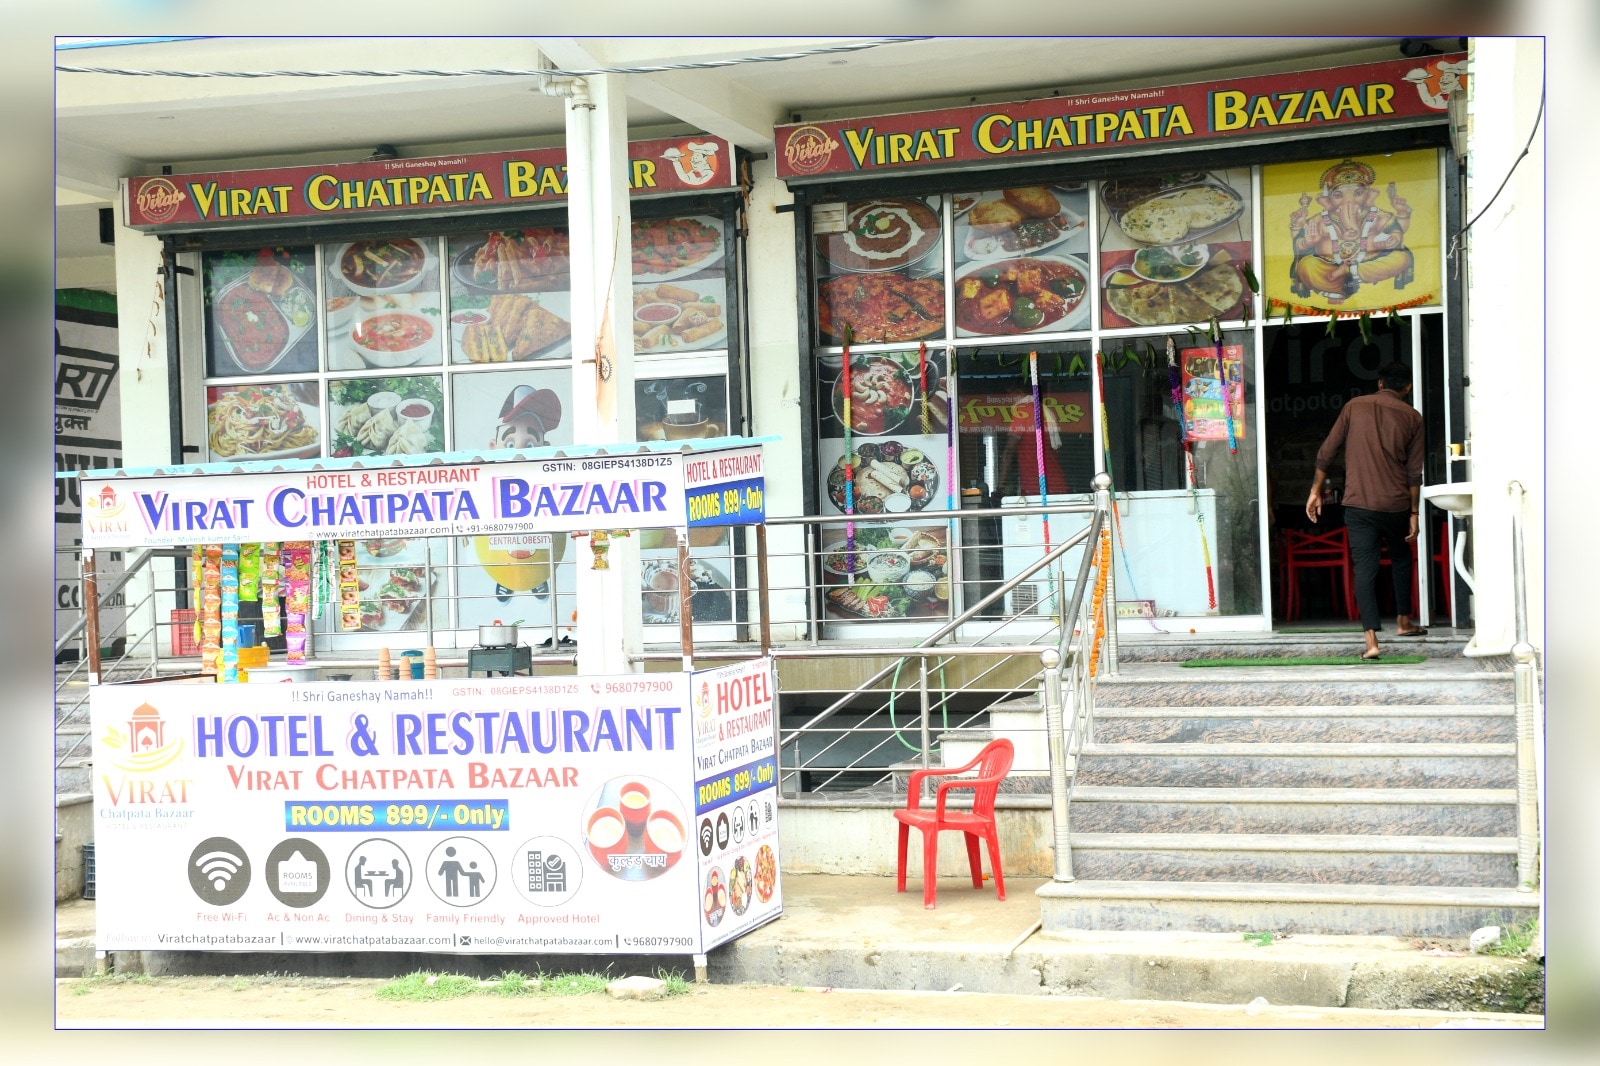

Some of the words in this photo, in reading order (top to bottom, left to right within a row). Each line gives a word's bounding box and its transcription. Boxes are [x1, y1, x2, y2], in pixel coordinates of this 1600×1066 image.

[1075, 97, 1090, 106] Shri
[1091, 94, 1129, 104] Ganeshay
[844, 126, 960, 169] VIRAT
[977, 105, 1194, 154] CHATPATA
[1211, 83, 1395, 132] BAZAAR
[391, 162, 404, 170] Shri
[405, 160, 437, 169] Ganeshay
[187, 181, 294, 220] VIRAT
[305, 171, 494, 212] CHATPATA
[542, 462, 576, 473] GSTIN:
[581, 457, 673, 471] 08GIEPS4138D1Z5
[686, 460, 711, 483] HOTEL
[712, 460, 718, 479] &
[719, 454, 761, 478] RESTAURANT
[306, 474, 356, 489] HOTEL
[361, 473, 374, 487] &
[378, 468, 480, 487] RESTAURANT
[139, 491, 255, 532] VIRAT
[272, 486, 480, 528] CHATPATA
[496, 478, 668, 519] BAZAAR
[688, 492, 721, 521] ROOMS
[746, 485, 763, 514] Only
[316, 526, 450, 539] www.viratchatpatabazaar.com
[466, 522, 534, 533] +91-9680797900
[489, 536, 521, 546] CENTRAL
[452, 686, 485, 697] GSTIN:
[490, 685, 579, 696] 08GIEPS4138D1Z5
[605, 681, 673, 694] 9680797900
[717, 672, 771, 715] HOTEL
[302, 690, 324, 702] Shri
[326, 689, 382, 704] Ganeshay
[384, 688, 434, 700] Namah!!
[195, 714, 334, 758] HOTEL
[349, 713, 380, 757] &
[394, 706, 682, 756] RESTAURANT
[718, 723, 725, 741] &
[726, 708, 772, 739] RESTAURANT
[697, 755, 716, 771] VIRAT
[718, 744, 749, 765] CHATPATA
[751, 736, 773, 754] BAZAAR
[226, 764, 303, 790] VIRAT
[315, 763, 455, 791] CHATPATA
[468, 762, 579, 788] BAZAAR
[699, 777, 731, 805] ROOMS
[757, 762, 774, 784] Only
[102, 774, 193, 807] VIRAT
[100, 808, 151, 821] Chatpata
[155, 807, 195, 819] Bazaar
[291, 805, 375, 826] ROOMS
[385, 804, 448, 829] 899/-
[453, 804, 505, 828] Only
[645, 854, 667, 867] चाय
[197, 912, 219, 922] Free
[221, 912, 247, 922] Wi-Fi
[267, 912, 281, 922] Ac
[283, 912, 291, 922] &
[294, 912, 314, 922] Non
[317, 912, 331, 922] Ac
[345, 912, 378, 925] Dining
[381, 913, 389, 923] &
[392, 913, 414, 925] Stay
[426, 913, 460, 925] Family
[463, 913, 506, 925] Friendly
[518, 914, 569, 925] Approved
[572, 914, 600, 924] Hotel
[157, 933, 276, 946] Viratchatpatabazaar
[296, 935, 451, 947] www.viratchatpatabazaar.com
[474, 935, 613, 947] hello@viratchatpatabazaar.com
[632, 936, 693, 947] 9680797900
